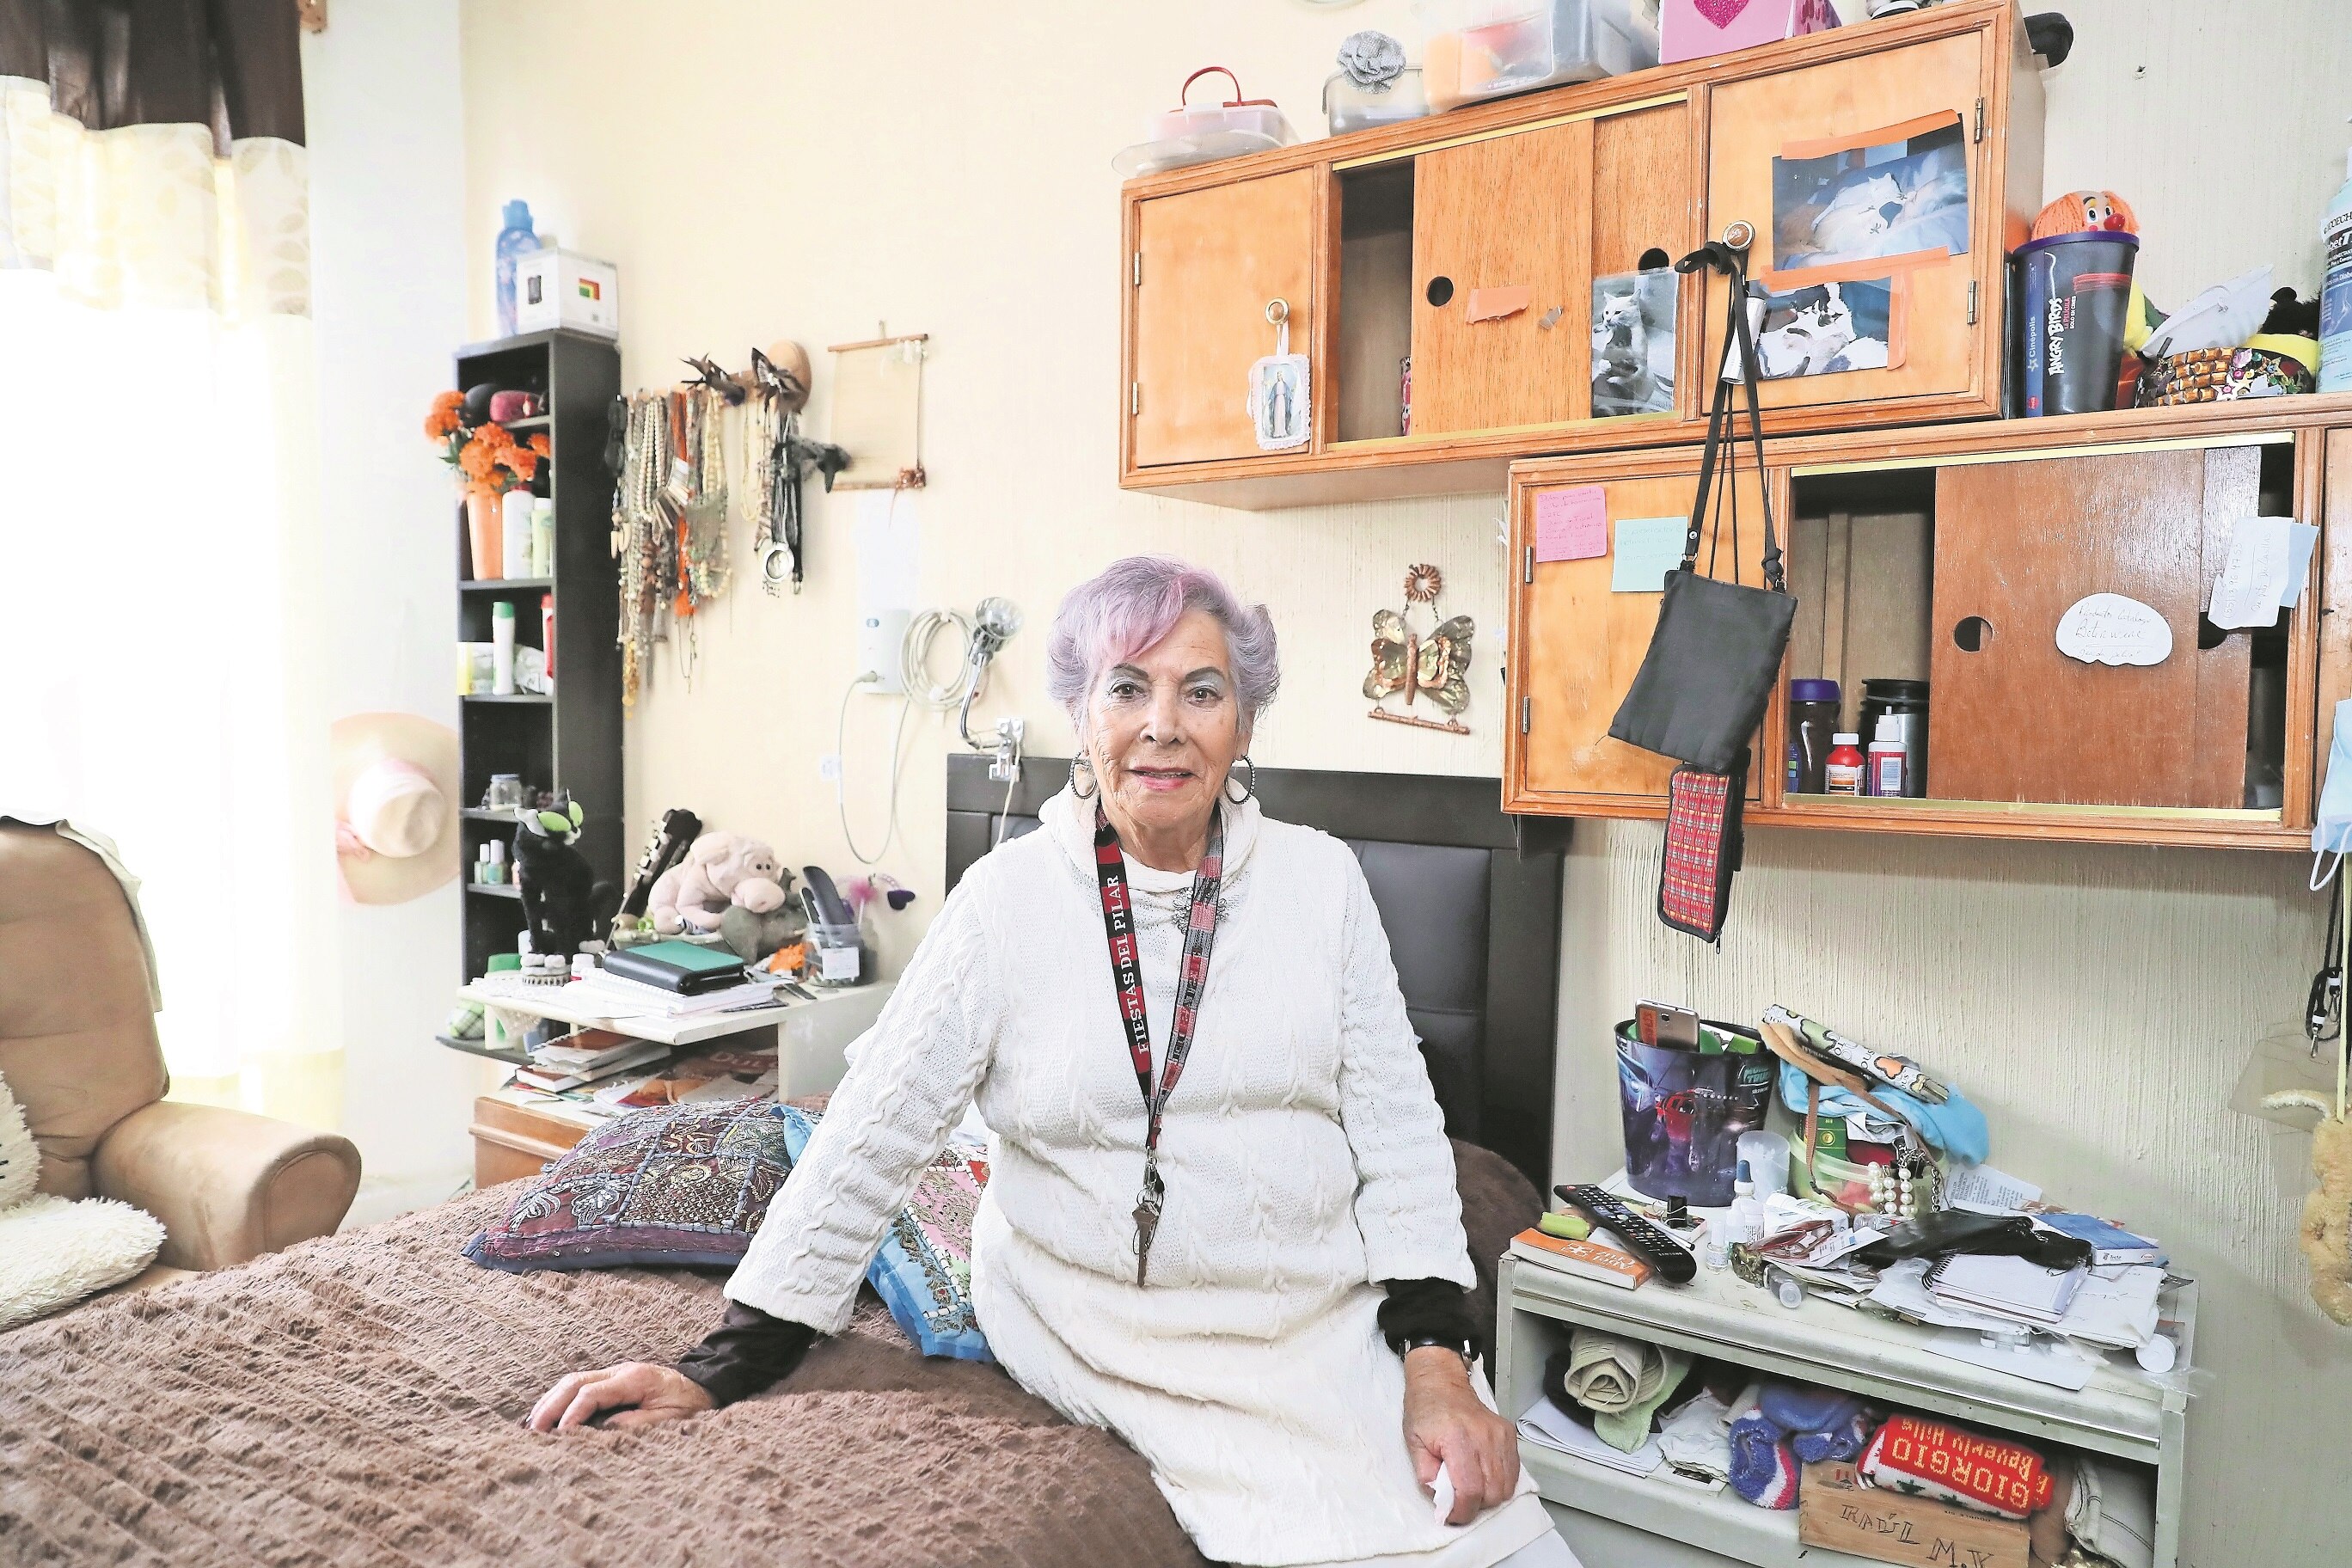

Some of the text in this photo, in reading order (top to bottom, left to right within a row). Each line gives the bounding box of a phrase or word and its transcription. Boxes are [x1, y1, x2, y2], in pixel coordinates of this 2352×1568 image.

[2048, 297, 2064, 377] ANGRY BIRDS
[1106, 874, 1149, 1055] FIESTAS DEL PILAR
[1891, 1436, 2030, 1509] GIORGIO
[1951, 1434, 2034, 1482] Beverly
